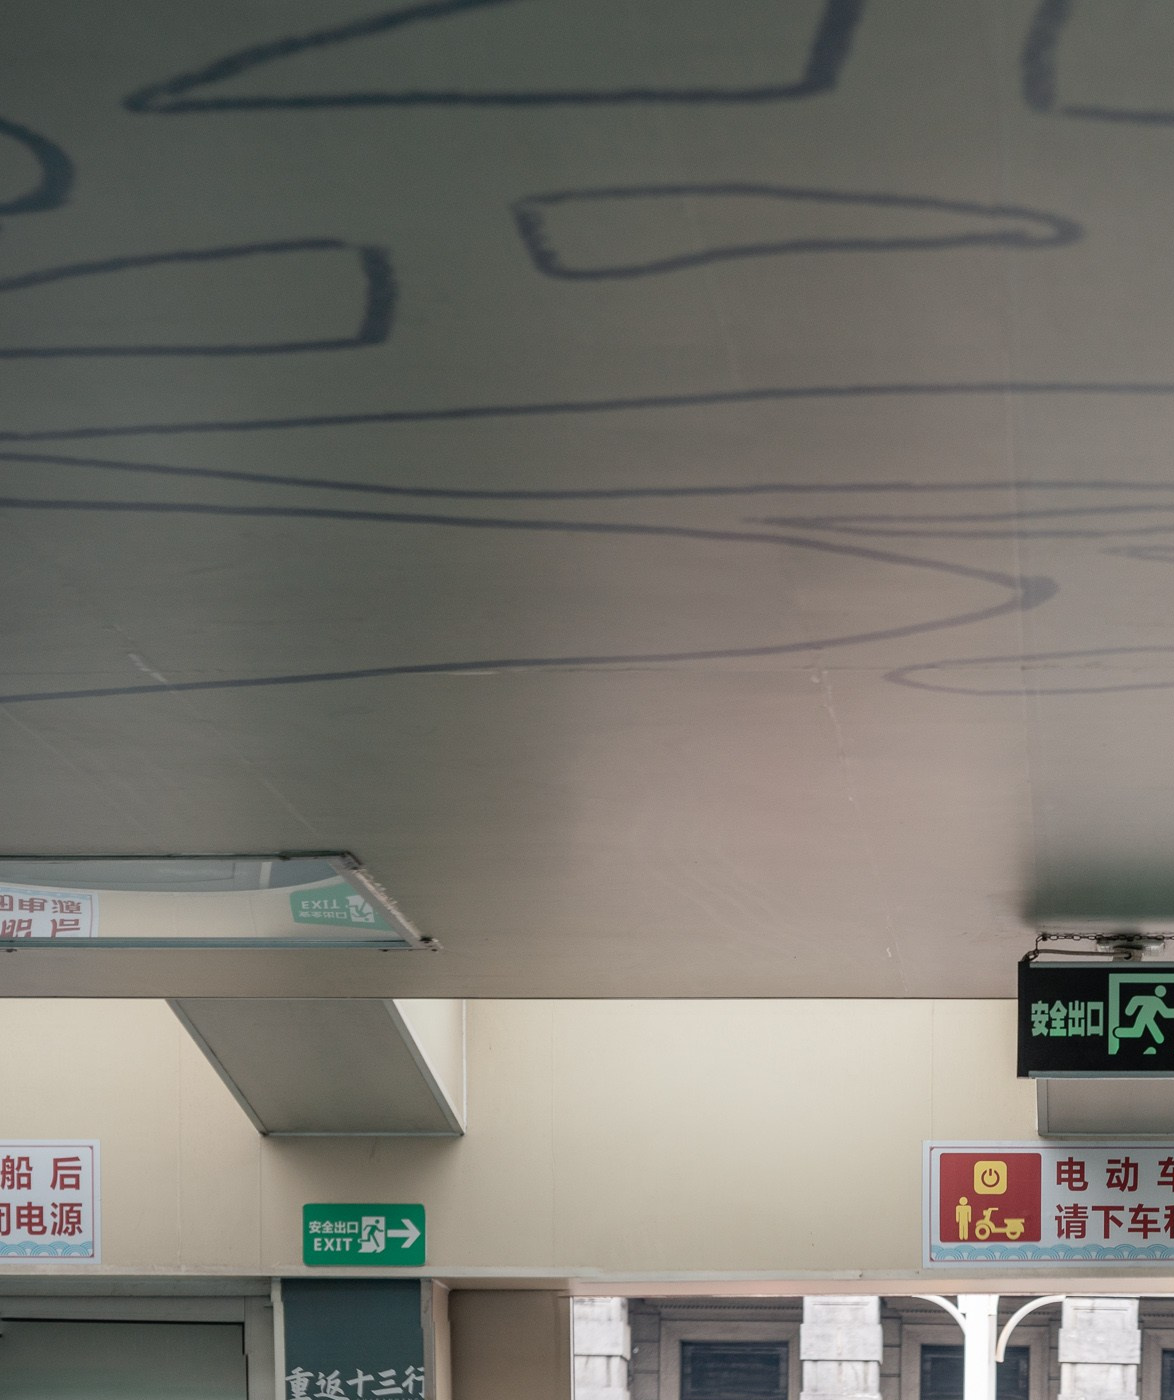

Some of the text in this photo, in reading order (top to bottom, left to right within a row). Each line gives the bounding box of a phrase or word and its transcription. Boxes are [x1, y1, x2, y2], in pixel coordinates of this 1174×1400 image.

[1031, 1000, 1104, 1037] 安全出口
[308, 1220, 359, 1234] 安全出口
[313, 1238, 352, 1252] EXIT
